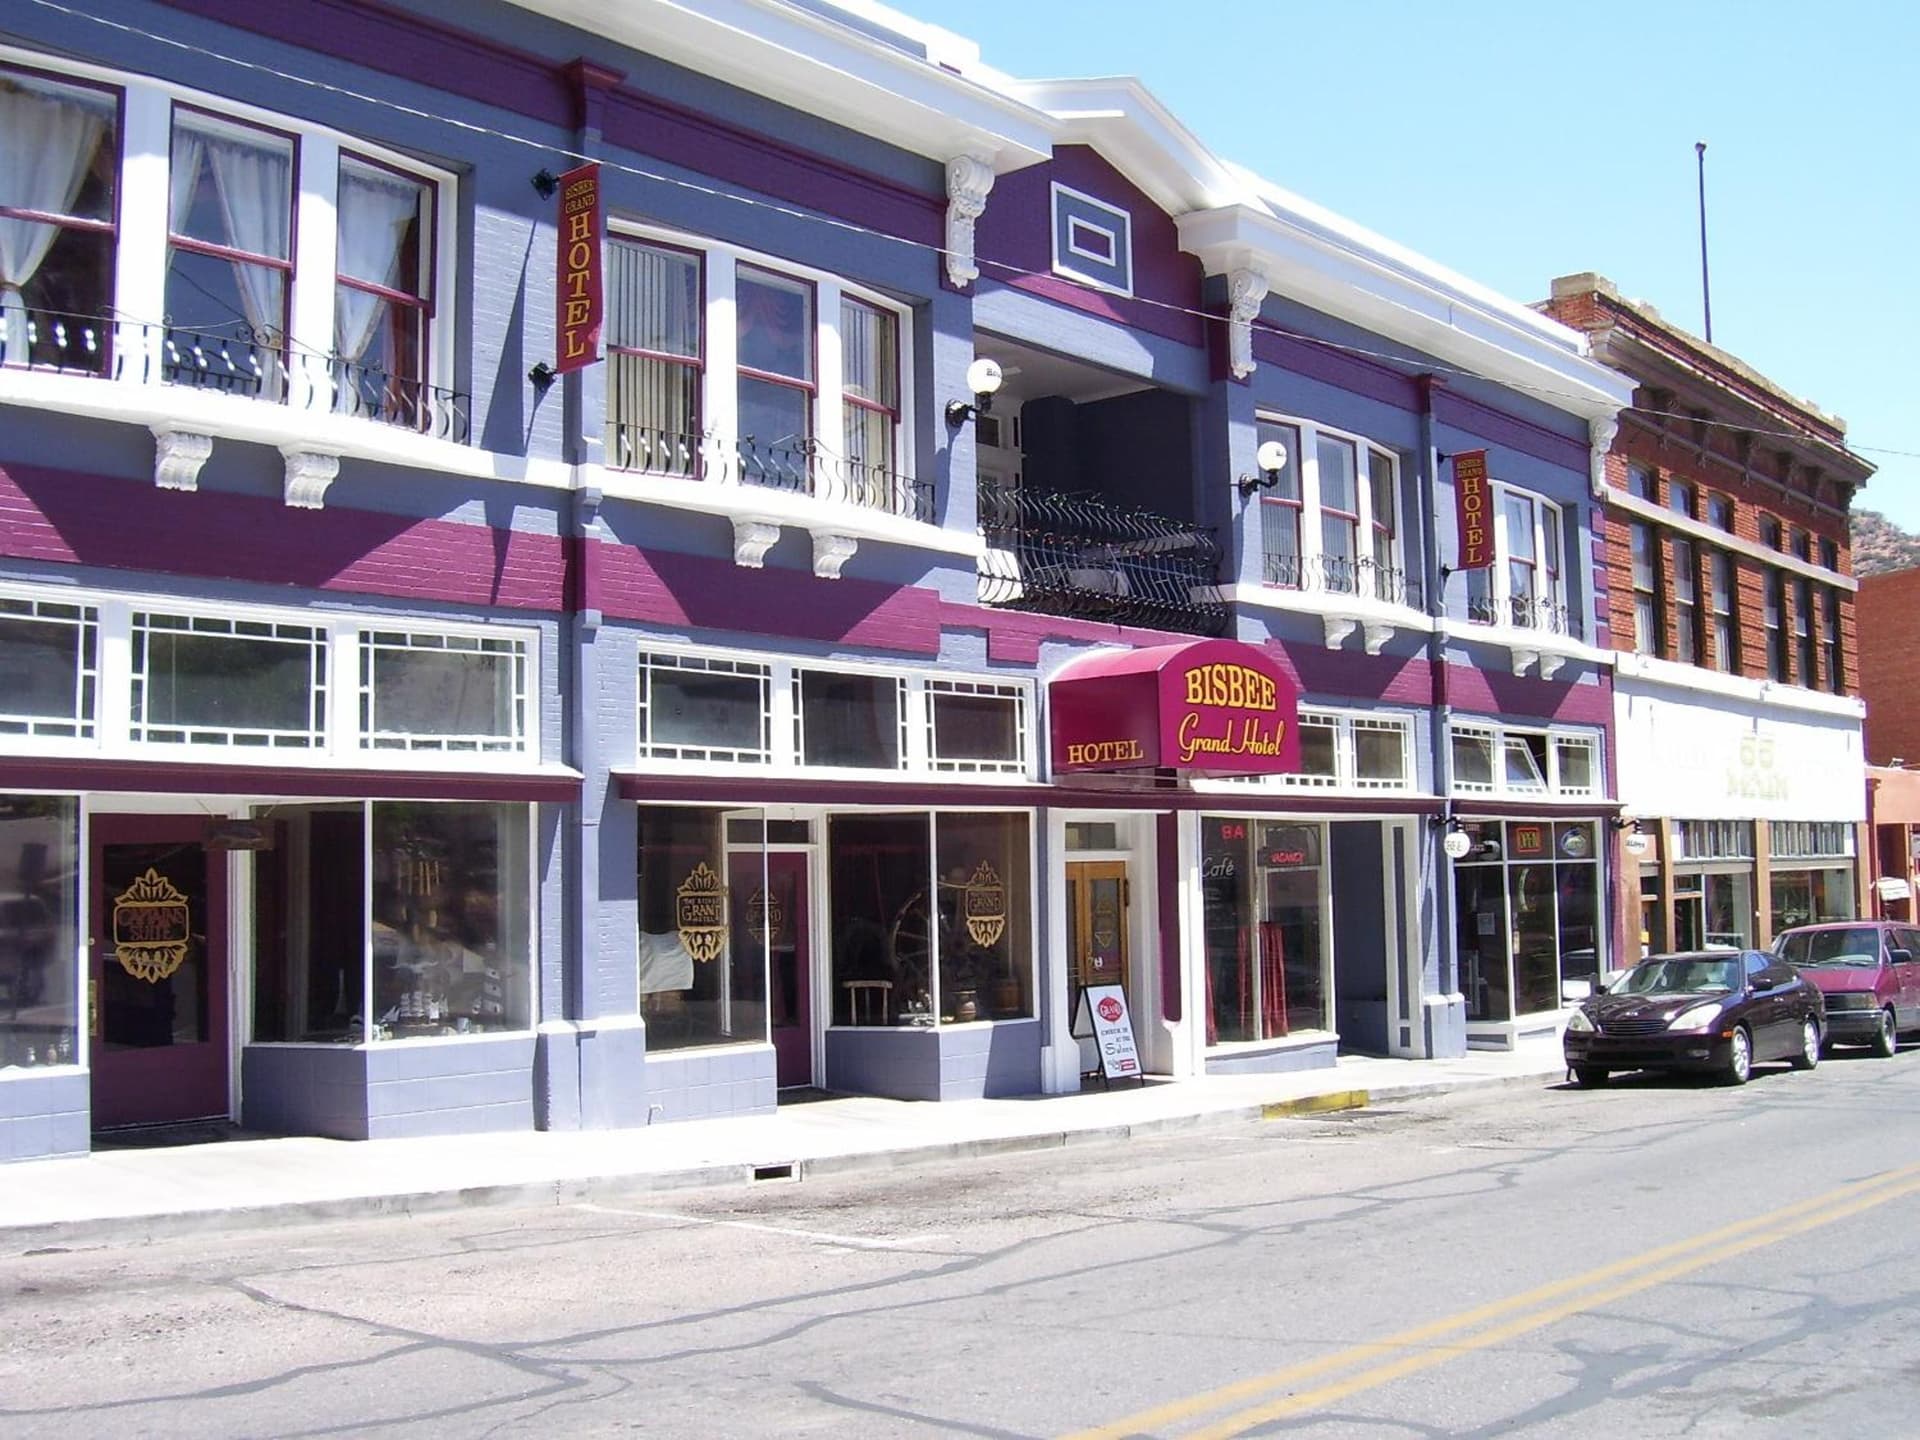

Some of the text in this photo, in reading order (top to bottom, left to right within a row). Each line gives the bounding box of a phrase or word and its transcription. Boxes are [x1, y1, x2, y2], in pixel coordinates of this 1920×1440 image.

[565, 194, 595, 213] GRAND
[565, 211, 592, 359] HOTEL
[1461, 477, 1483, 563] HOTEL
[1184, 663, 1277, 711] BISBEE
[1067, 739, 1144, 765] HOTEL
[1178, 712, 1286, 762] Grand Hotel
[1200, 857, 1234, 877] Café
[681, 904, 721, 921] GRAND
